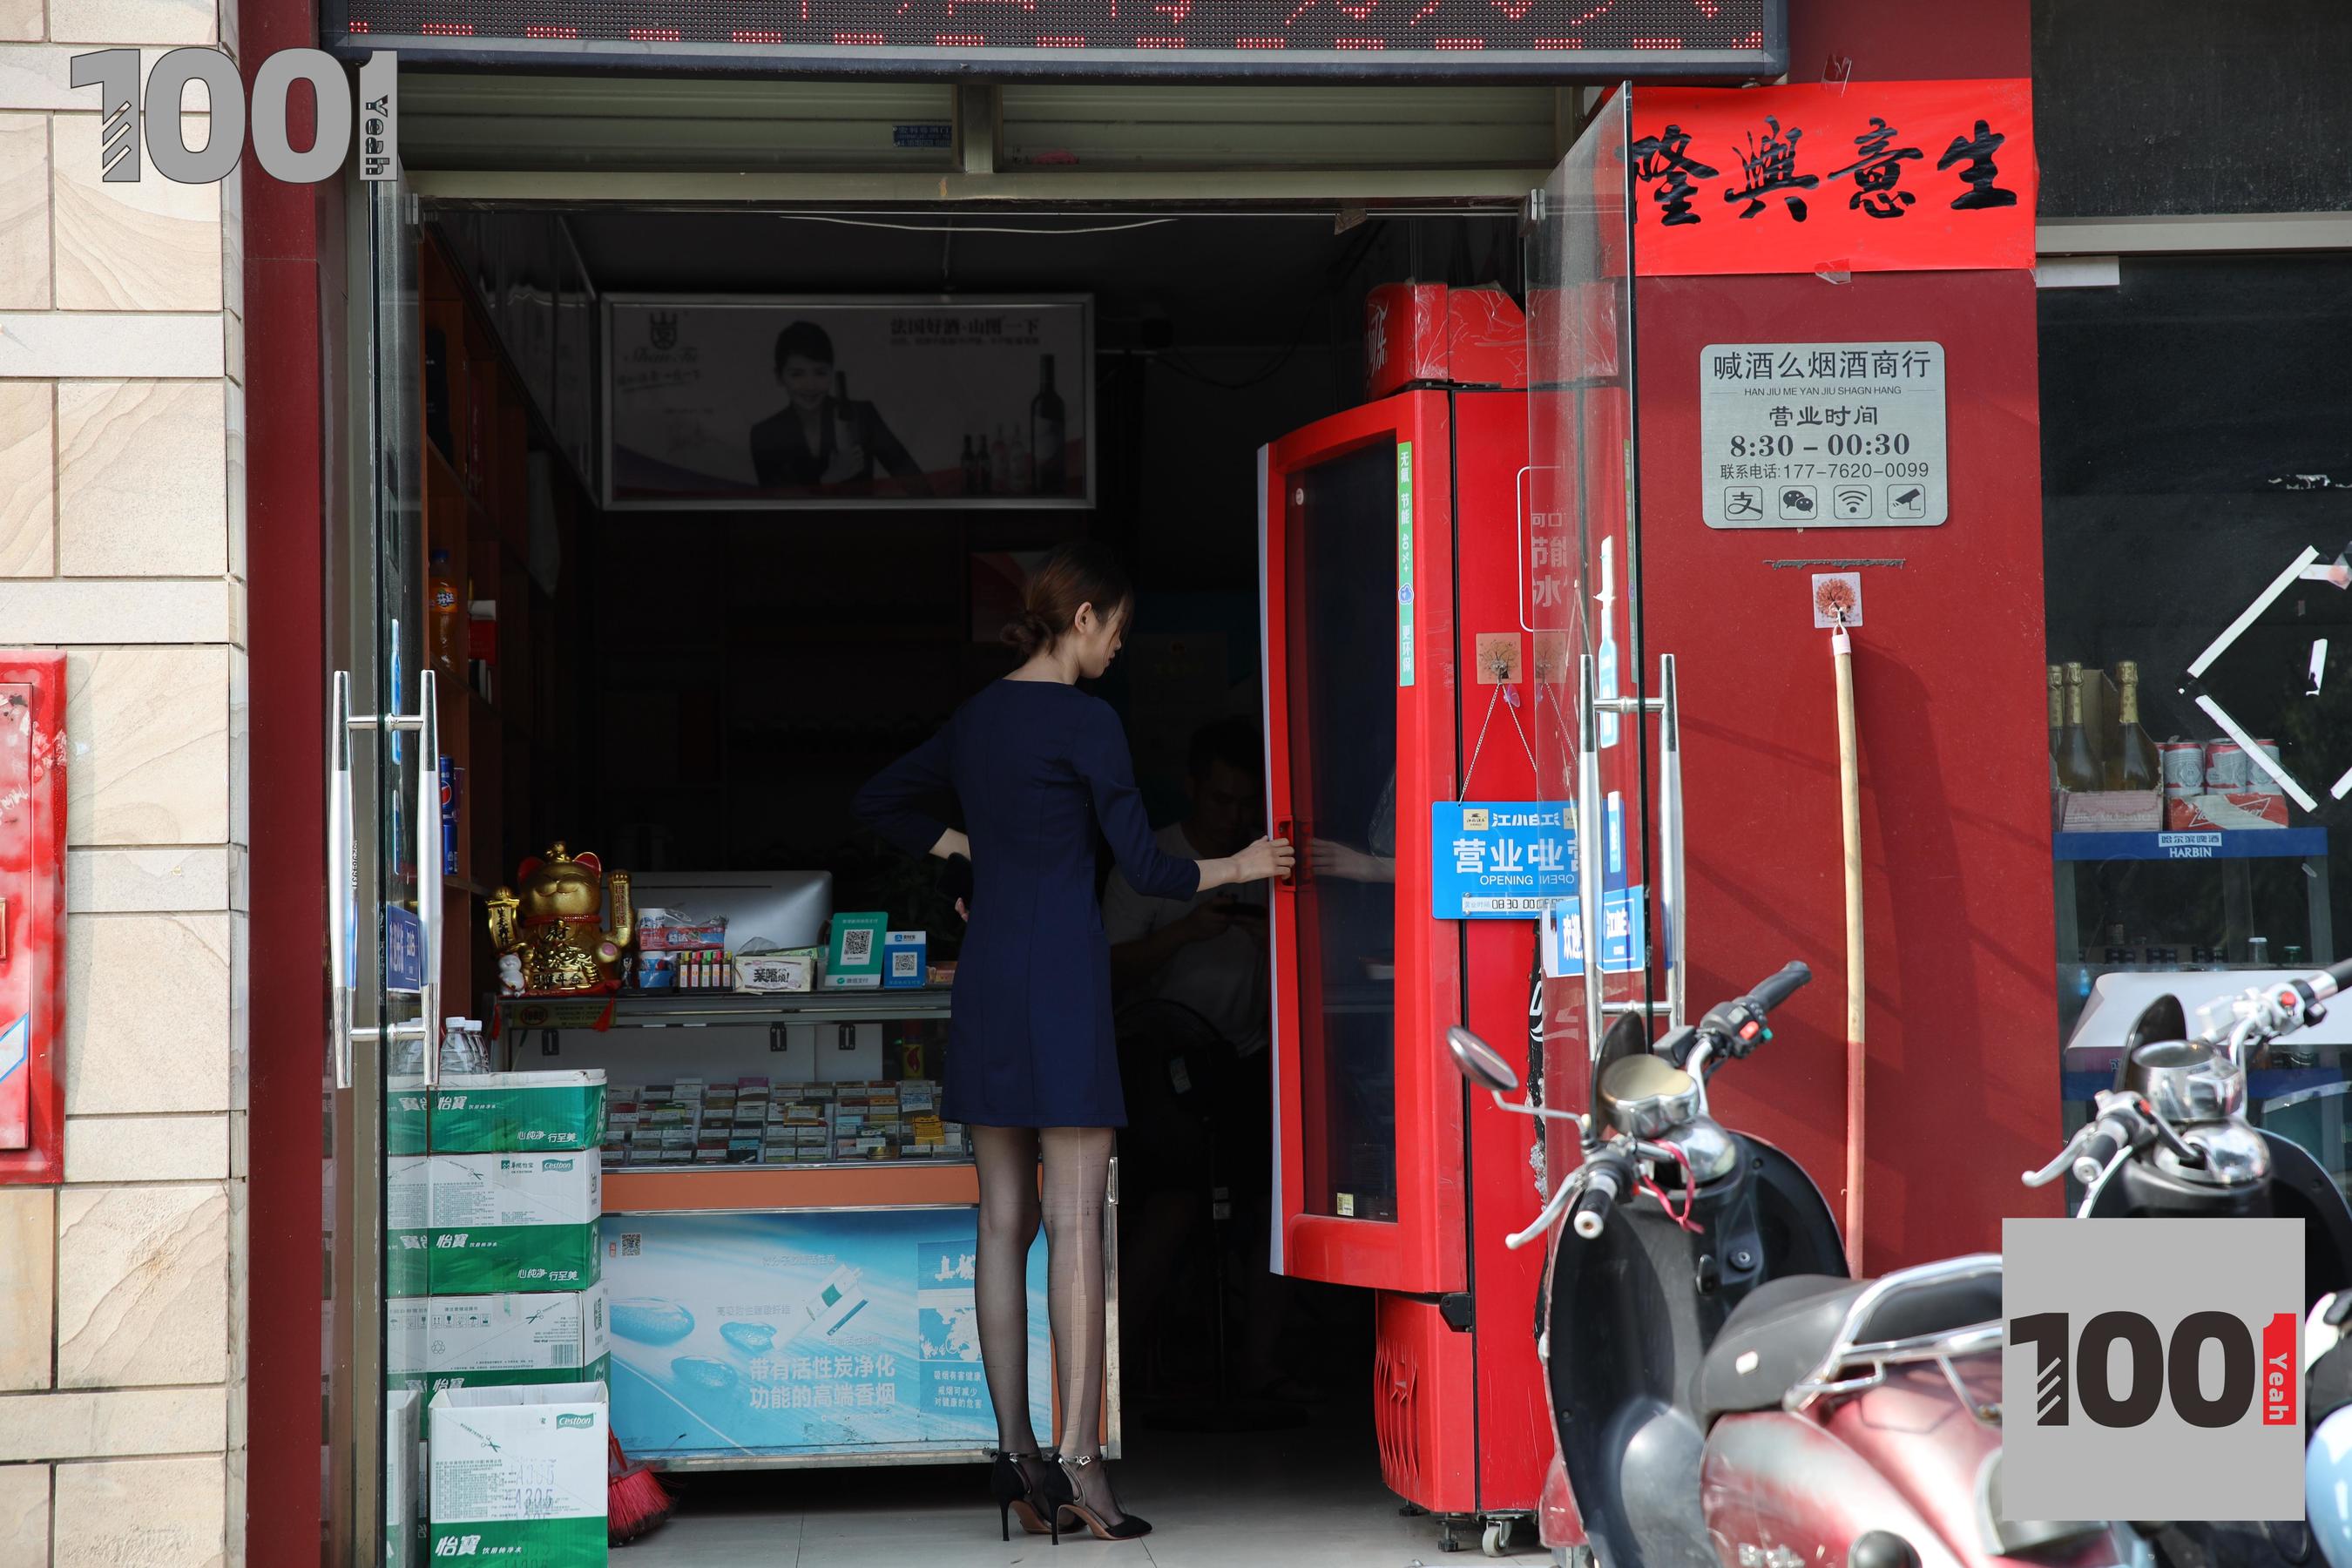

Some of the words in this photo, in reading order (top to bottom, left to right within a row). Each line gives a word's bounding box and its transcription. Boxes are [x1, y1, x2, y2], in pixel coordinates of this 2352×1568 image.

[1713, 349, 1931, 381] 喊酒么烟酒商行
[1767, 388, 1781, 396] JIU
[1838, 387, 1872, 395] SHAGN
[1874, 386, 1902, 395] HANG
[1769, 405, 1878, 427] 营业时间
[1730, 435, 1794, 457] 8:30
[1828, 433, 1910, 456] 00:30
[2169, 847, 2213, 858] HARBIN
[1479, 875, 1534, 885] OPENING
[749, 1355, 896, 1381] 带有活性炭净化
[934, 1370, 982, 1382] 吸烟有害健康
[749, 1382, 896, 1409] 功能的高端香烟
